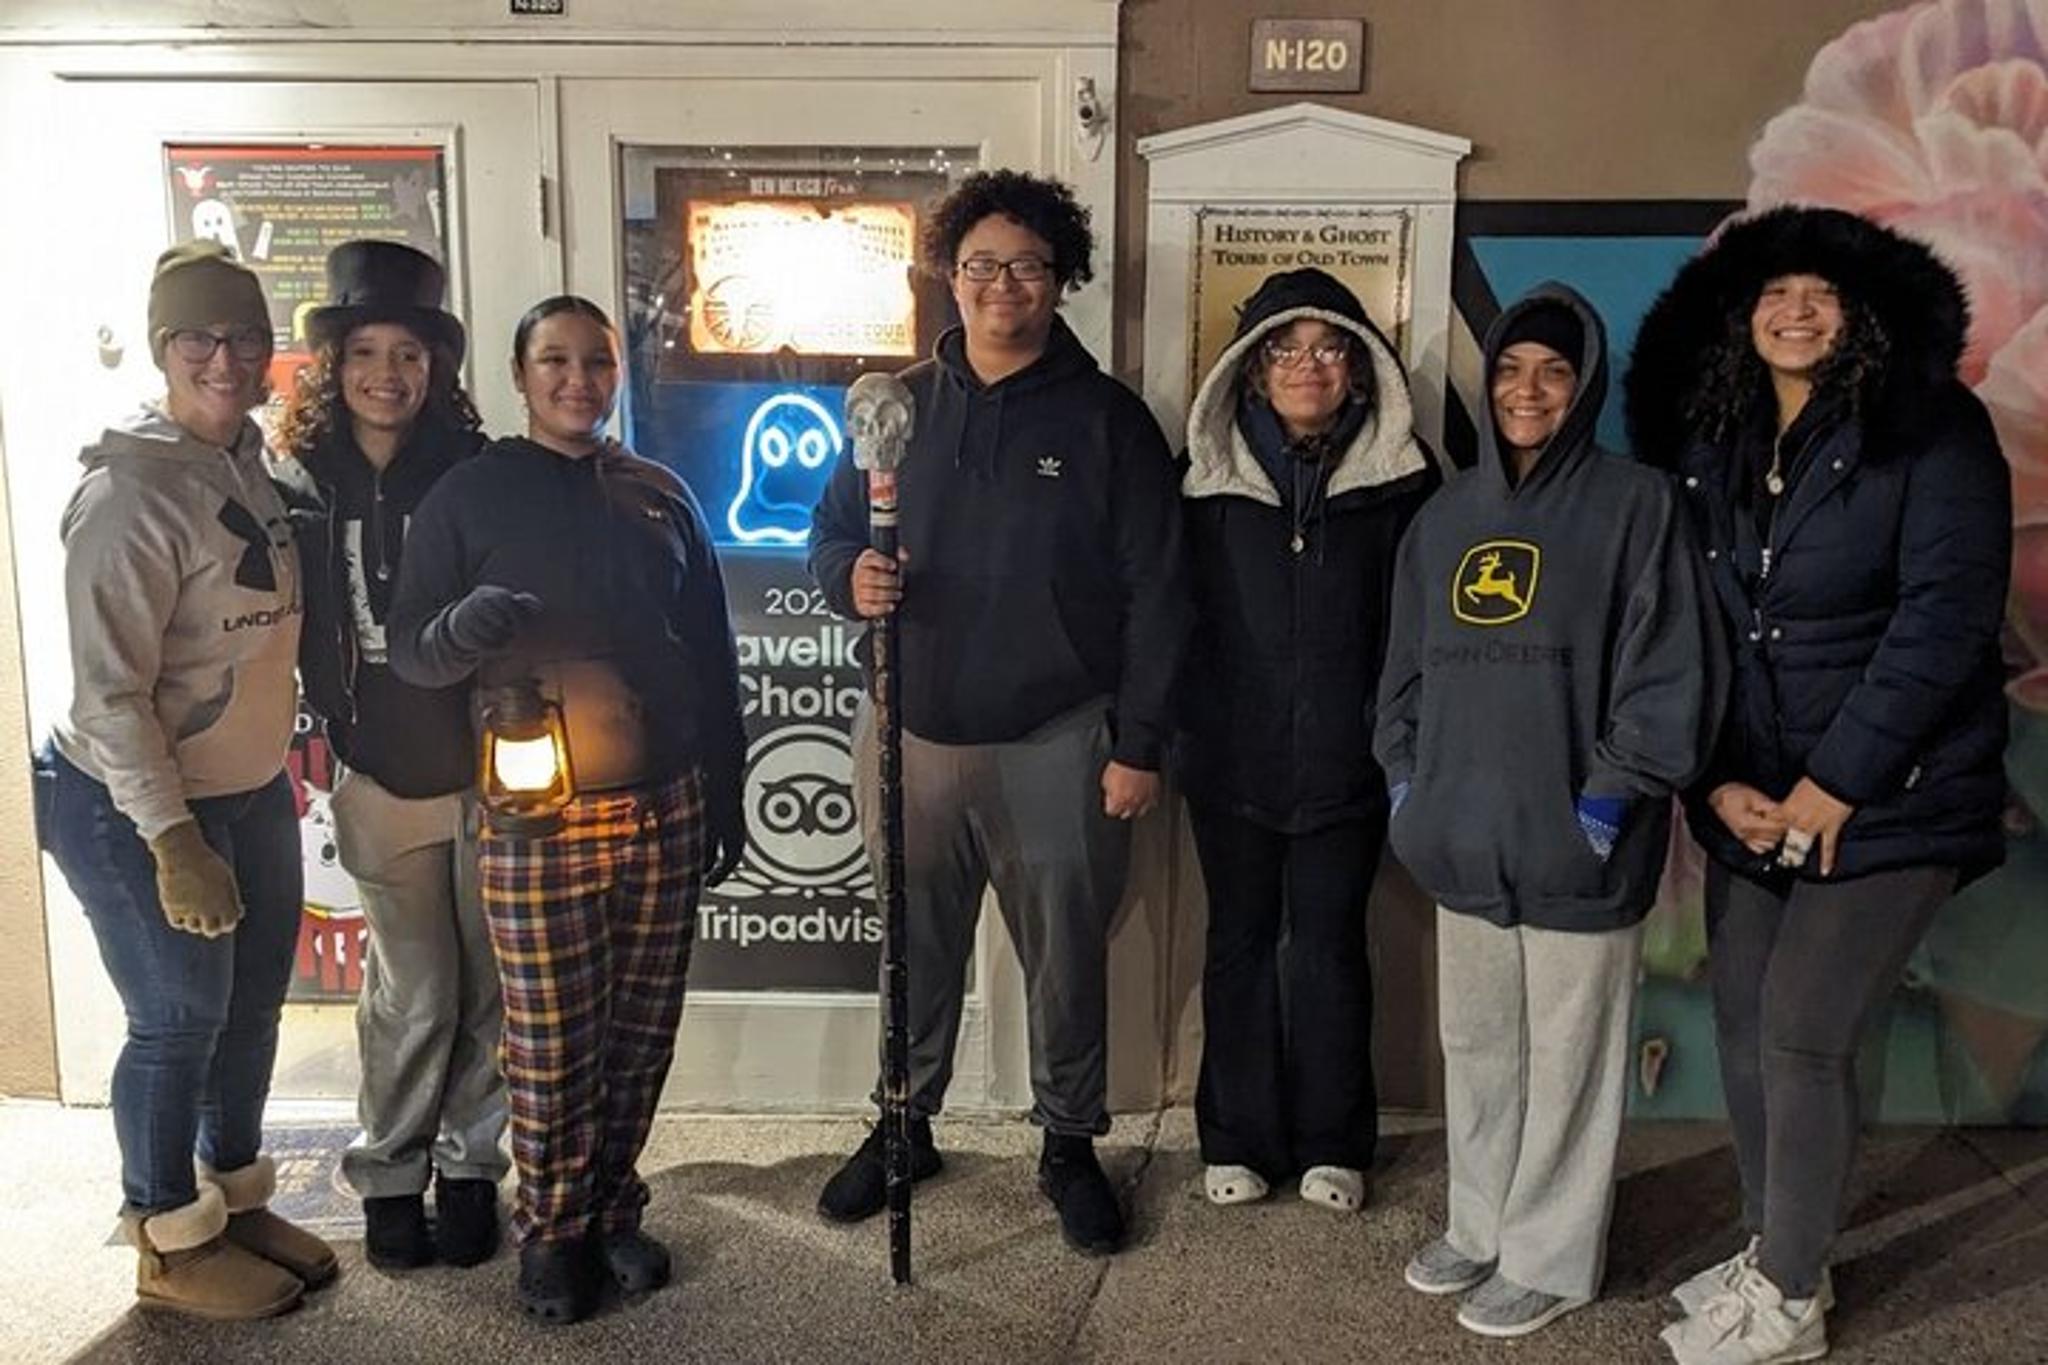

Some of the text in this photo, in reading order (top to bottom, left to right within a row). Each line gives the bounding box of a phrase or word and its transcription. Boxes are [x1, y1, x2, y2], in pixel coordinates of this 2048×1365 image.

[1215, 225, 1391, 243] HISTORY & GHOST
[1213, 250, 1267, 265] TOURS
[1297, 250, 1335, 265] OLD
[1338, 250, 1389, 265] TOWN
[764, 587, 845, 620] 202
